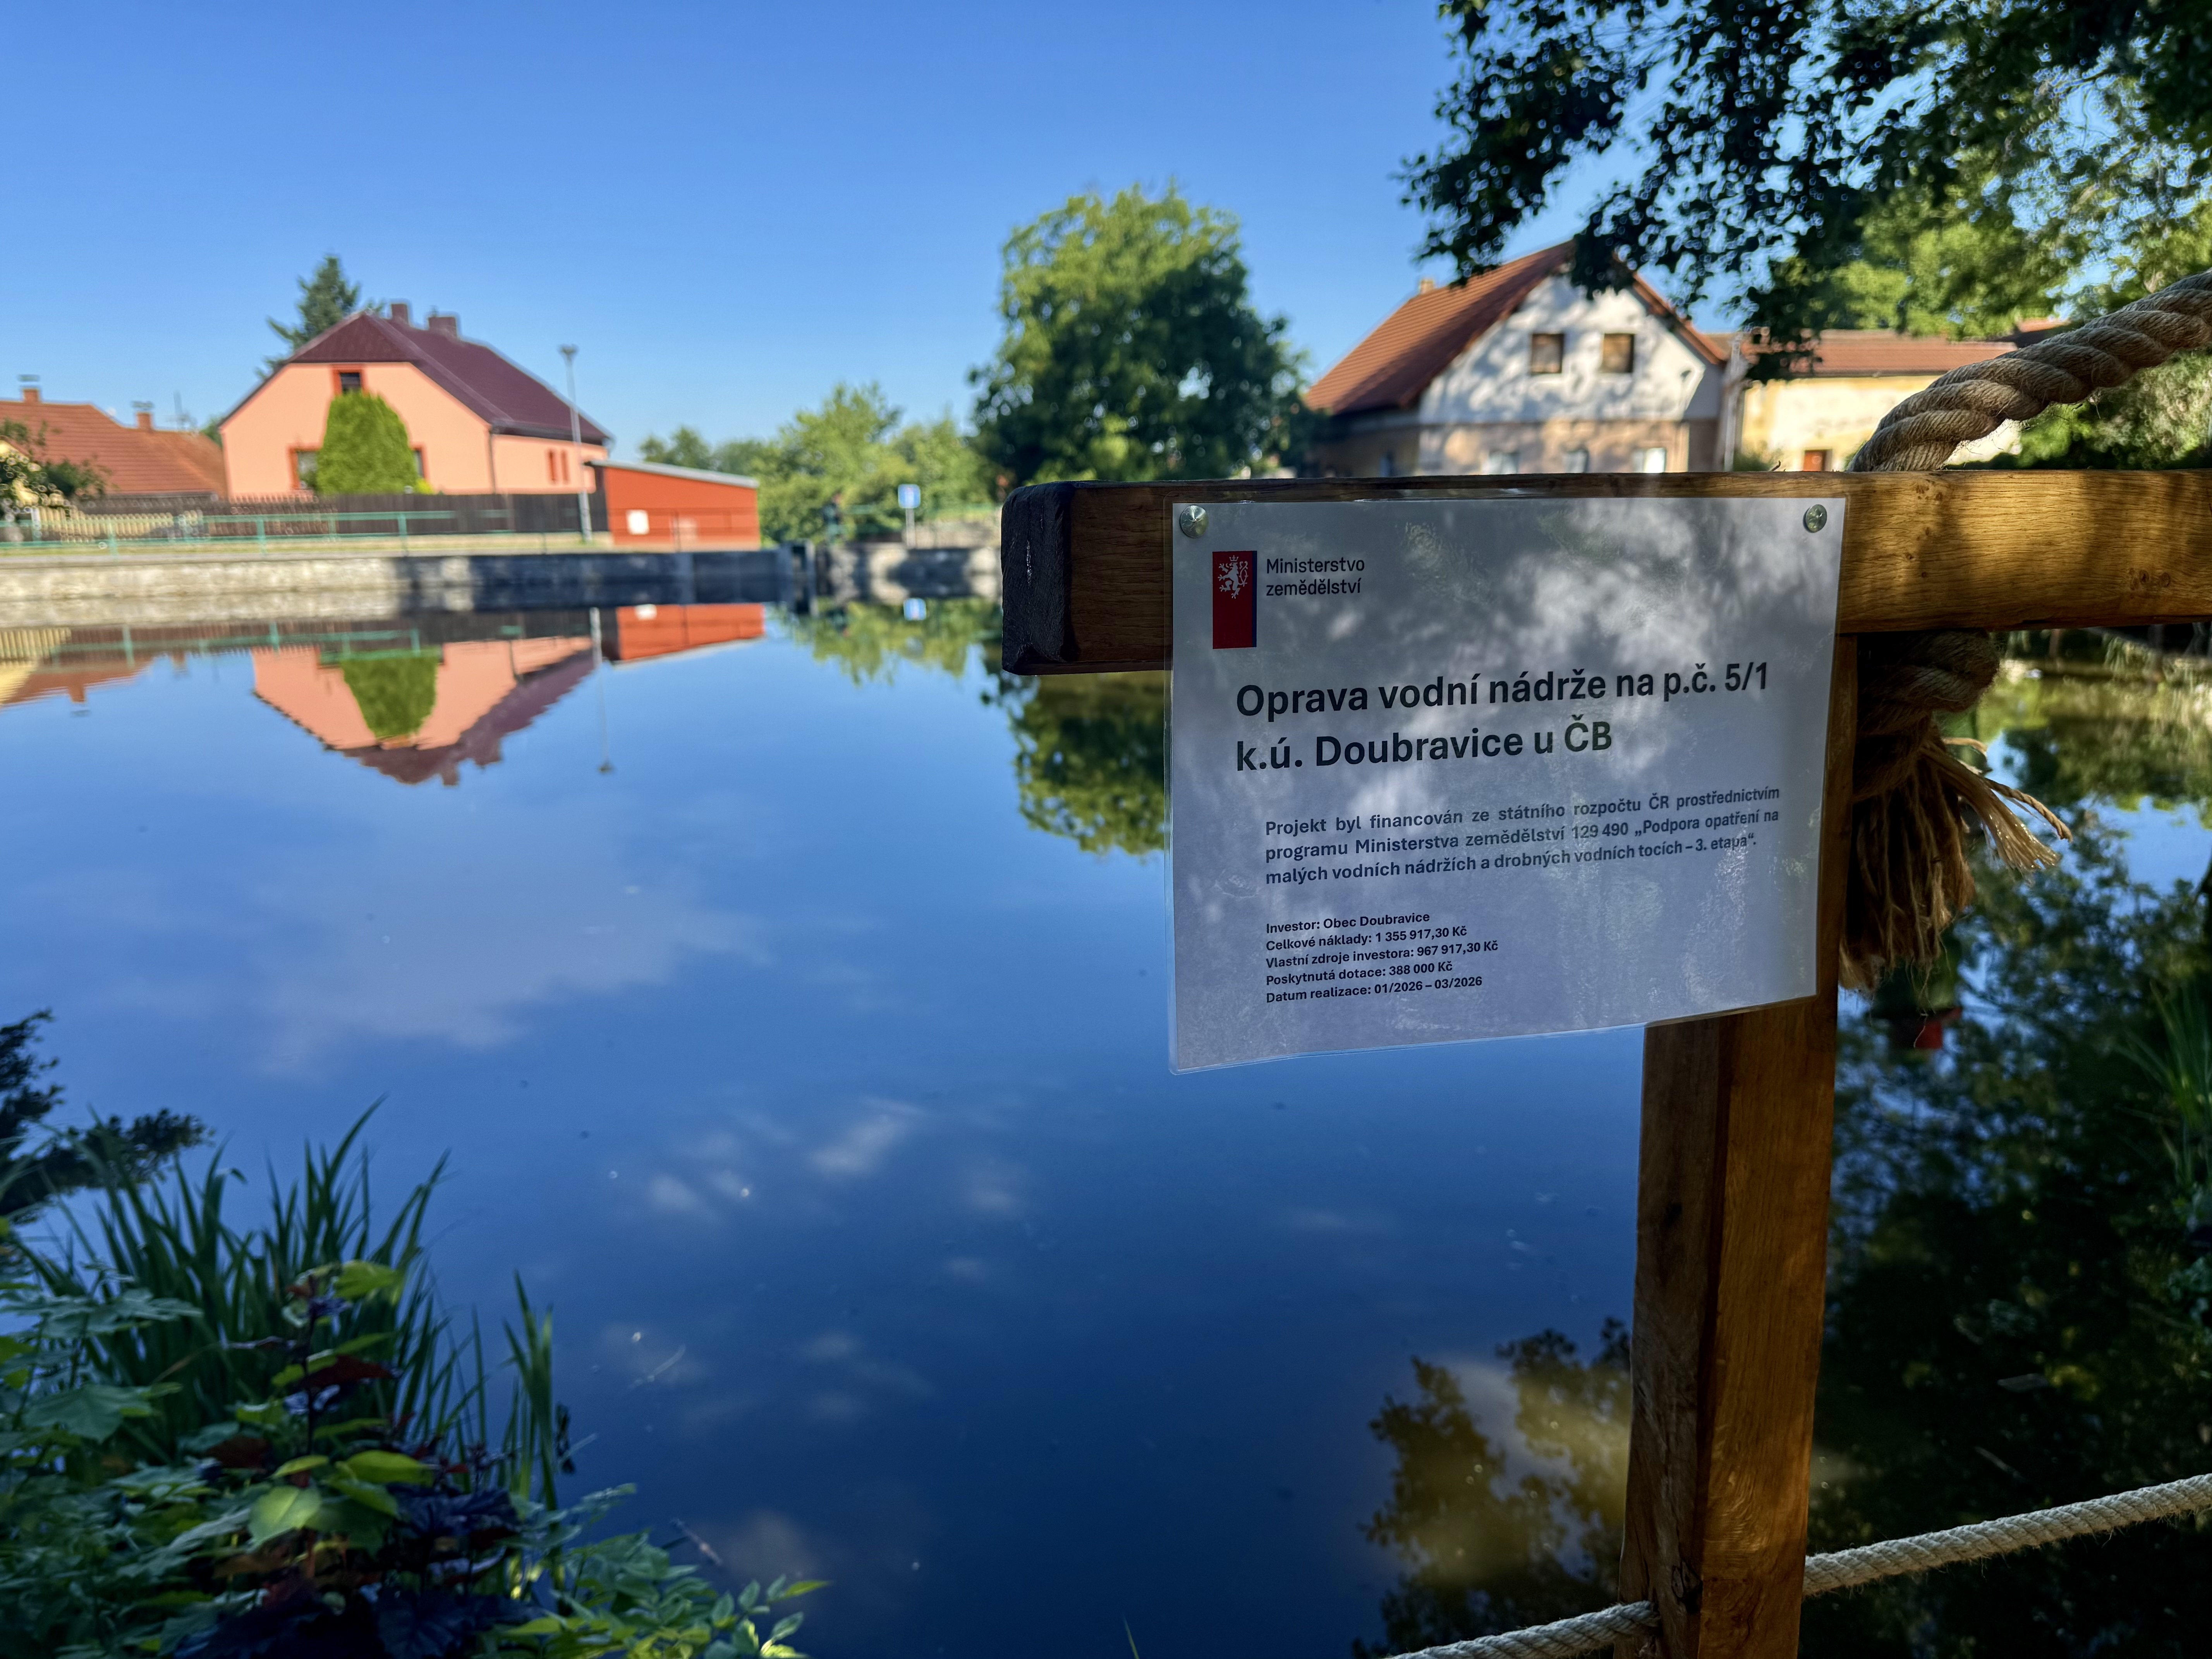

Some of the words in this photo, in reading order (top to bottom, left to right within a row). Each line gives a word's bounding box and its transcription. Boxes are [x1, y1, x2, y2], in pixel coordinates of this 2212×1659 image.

[1267, 557, 1364, 574] Ministerstvo
[1266, 578, 1361, 596] zemědělství
[1237, 685, 1367, 722] Oprava
[1378, 673, 1479, 708] vodní
[1490, 669, 1606, 703] nádrže
[1616, 673, 1654, 697] na
[1664, 663, 1716, 702] p.č.
[1725, 662, 1767, 691] 5/1
[1237, 737, 1302, 771] k.ú.
[1317, 728, 1523, 766] Doubravice
[1535, 732, 1553, 754] u
[1565, 714, 1612, 752] ČB
[1266, 819, 1326, 837] Projekt
[1336, 816, 1361, 833] byl
[1370, 810, 1462, 828] financován
[1472, 811, 1489, 822] ze
[1499, 804, 1565, 820] státního
[1574, 799, 1640, 817] rozpočtu
[1649, 793, 1669, 809] ČR
[1676, 786, 1779, 810] prostřednictvím
[1266, 844, 1347, 862] programu
[1356, 836, 1458, 853] Ministerstva
[1466, 826, 1565, 846] zemědělství
[1571, 824, 1598, 840] 129
[1602, 823, 1628, 836] 490
[1705, 809, 1760, 830] opatření
[1764, 811, 1778, 821] na
[1266, 867, 1327, 884] malých
[1332, 862, 1400, 879] vodních
[1405, 857, 1475, 874] nádržích
[1481, 859, 1489, 869] a
[1494, 850, 1570, 867] drobných
[1574, 842, 1635, 862] vodních
[1638, 841, 1682, 857] tocích
[1695, 838, 1707, 851] 3.
[1267, 922, 1319, 933] Investor:
[1324, 918, 1356, 928] Obec
[1360, 913, 1430, 926] Doubravice
[1266, 936, 1315, 950] Celkové
[1319, 934, 1371, 946] náklady:
[1376, 933, 1381, 942] 1
[1386, 931, 1407, 941] 355
[1410, 928, 1449, 940] 917,30
[1453, 926, 1467, 936] Kč
[1266, 954, 1309, 968] Vlastní
[1312, 952, 1349, 964] zdroje
[1353, 950, 1413, 961] investora:
[1417, 946, 1438, 956] 967
[1441, 943, 1480, 955] 917,30
[1484, 940, 1498, 951] Kč
[1267, 970, 1335, 985] Poskytnutá
[1339, 969, 1385, 979] dotace:
[1389, 965, 1410, 975] 388
[1413, 963, 1434, 974] 000
[1438, 961, 1452, 972] Kč
[1267, 992, 1307, 1003] Datum
[1311, 987, 1371, 998] realizace:
[1375, 981, 1422, 993] 01/2026
[1435, 976, 1482, 989] 03/2026
